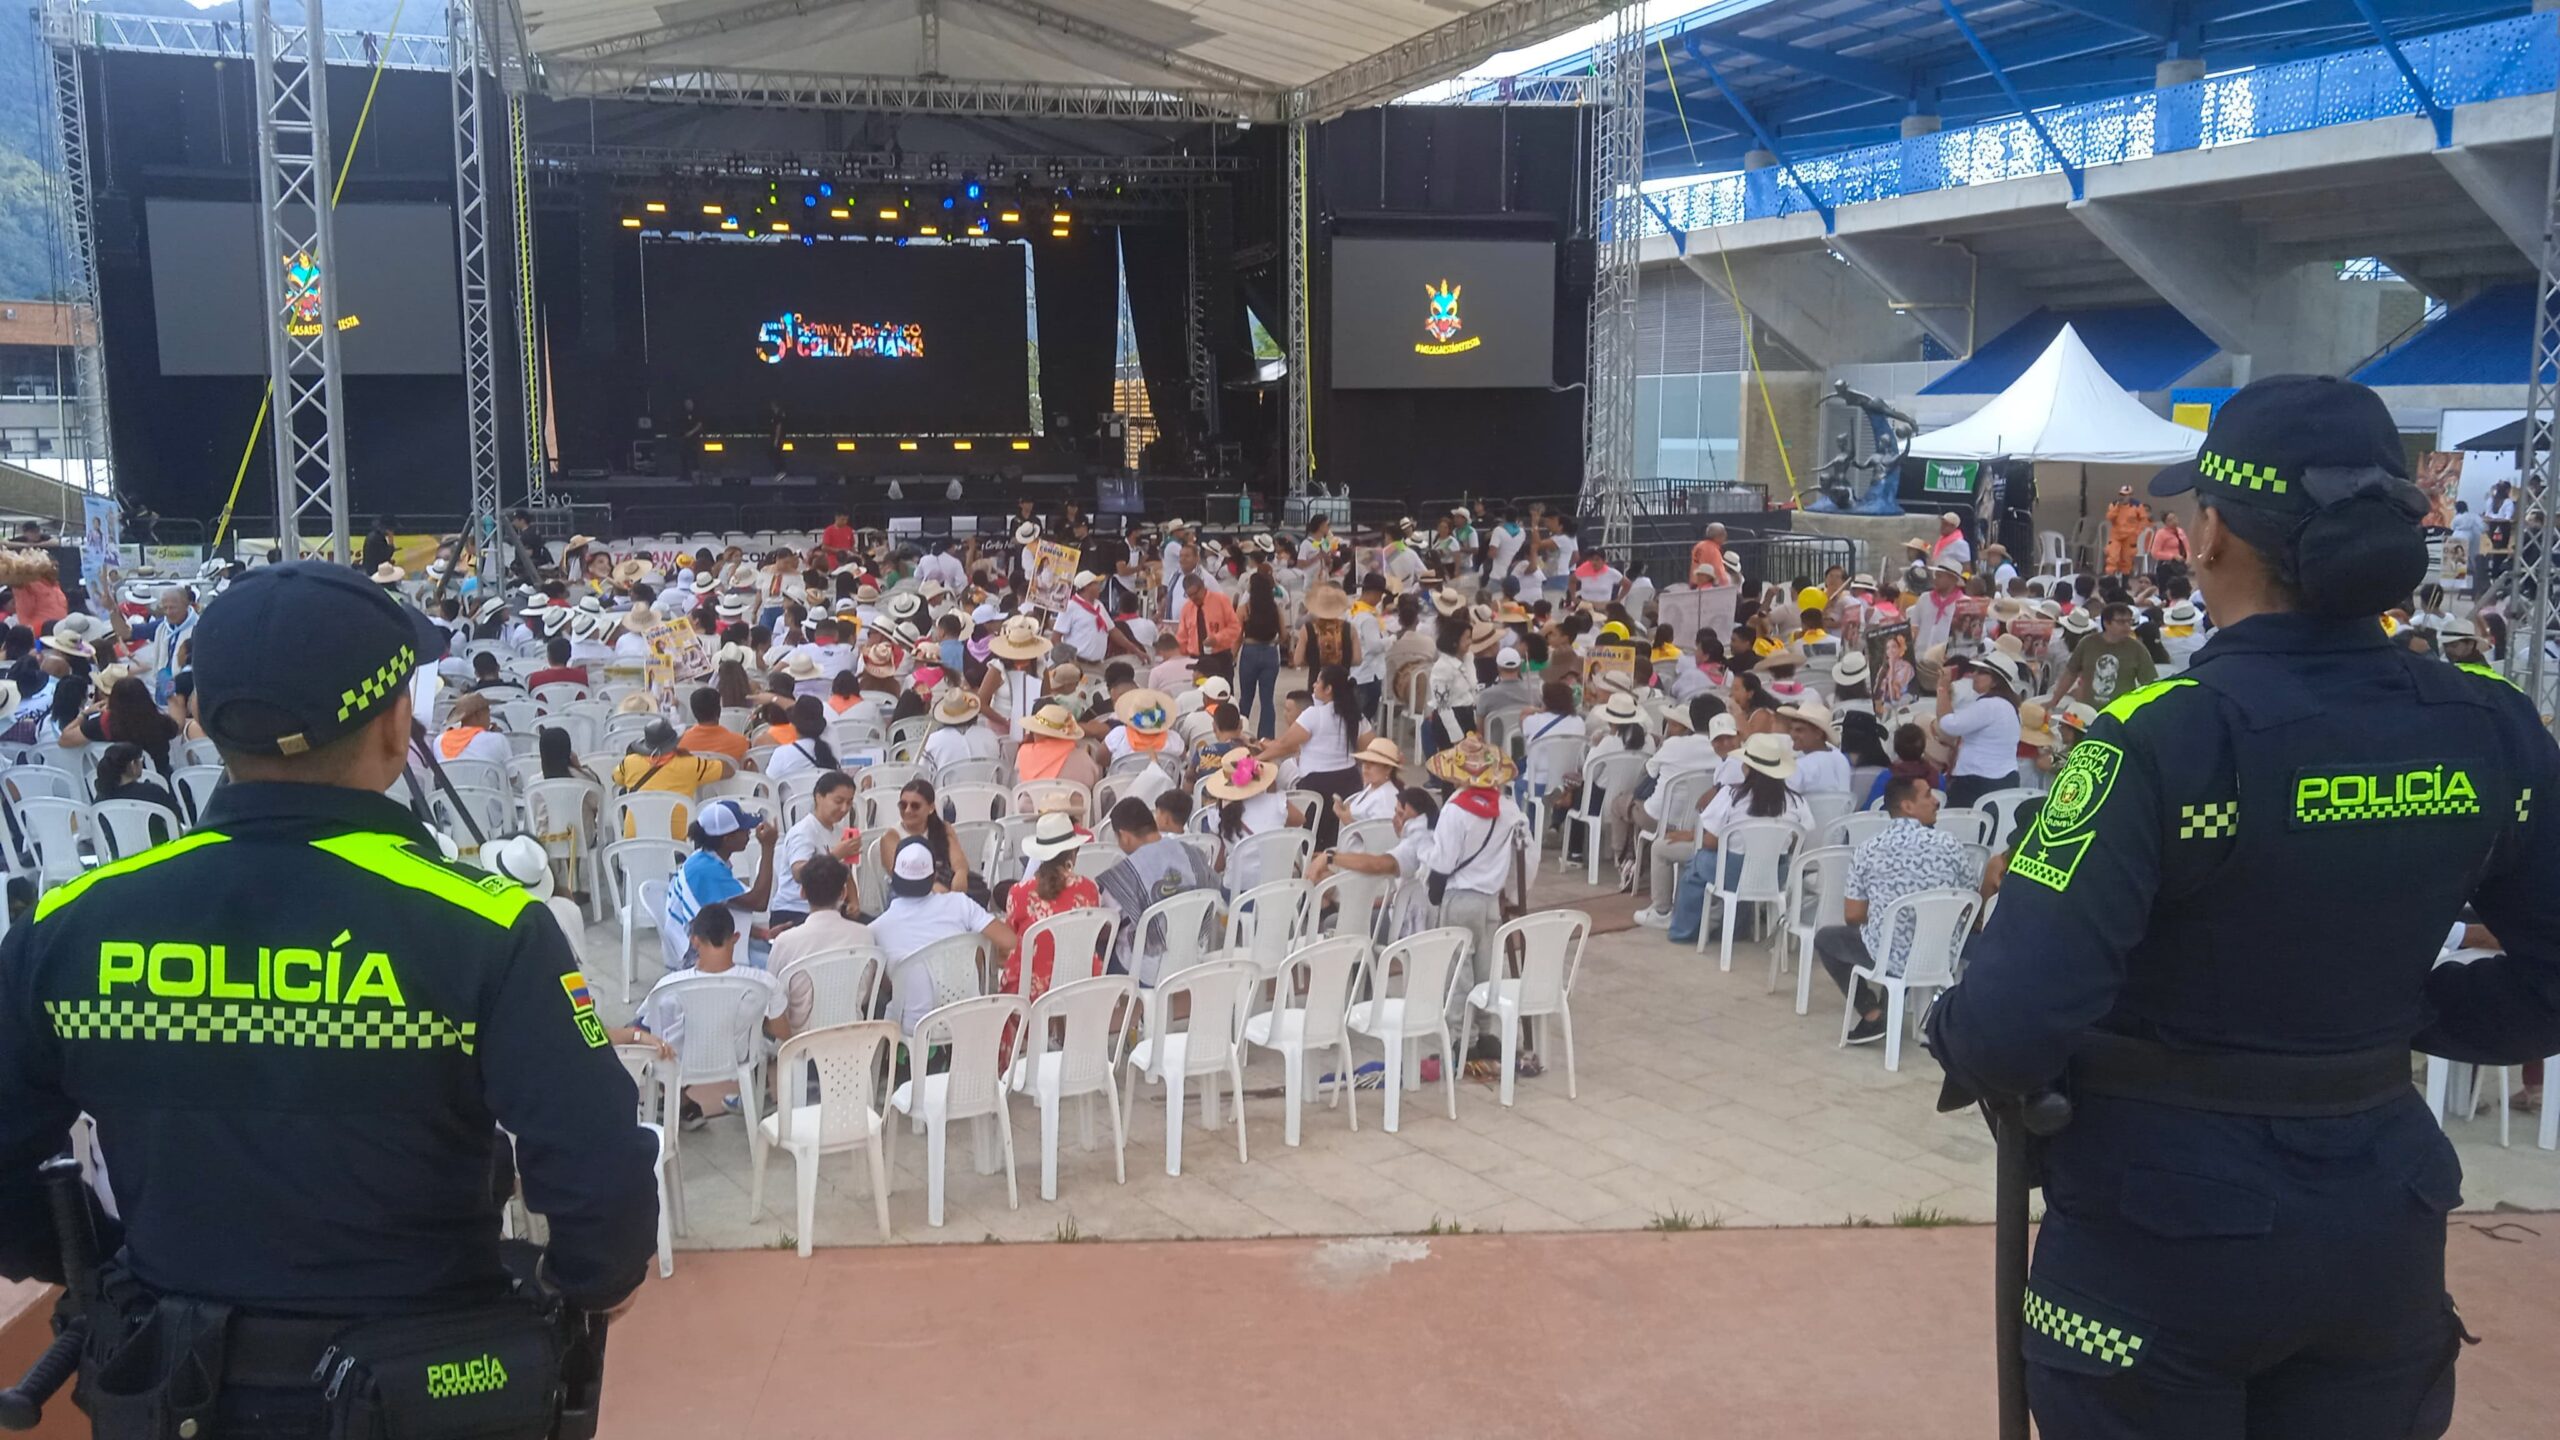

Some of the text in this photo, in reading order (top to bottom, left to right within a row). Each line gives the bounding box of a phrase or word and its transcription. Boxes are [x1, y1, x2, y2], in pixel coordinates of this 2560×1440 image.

[2296, 763, 2478, 809] POLICÍA
[98, 928, 406, 1008] POLICÍA
[427, 1353, 502, 1386] POLICÍA
